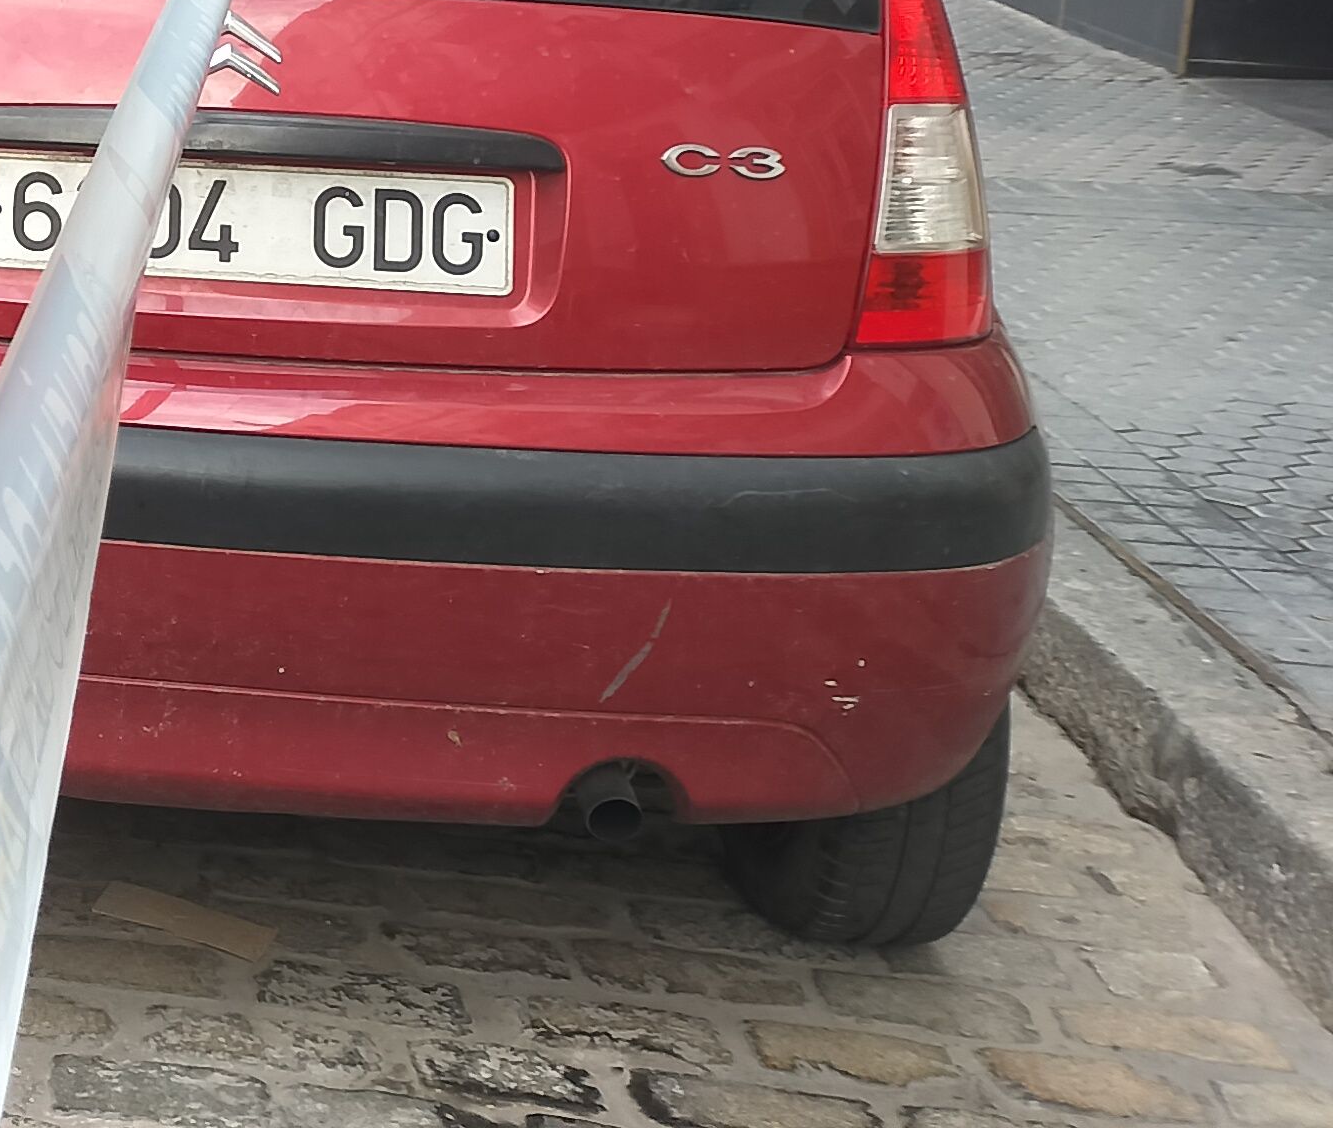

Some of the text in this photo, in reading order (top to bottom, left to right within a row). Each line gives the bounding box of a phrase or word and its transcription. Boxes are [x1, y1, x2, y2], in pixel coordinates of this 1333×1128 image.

[660, 142, 786, 180] C3
[12, 171, 484, 275] 604 GDG
